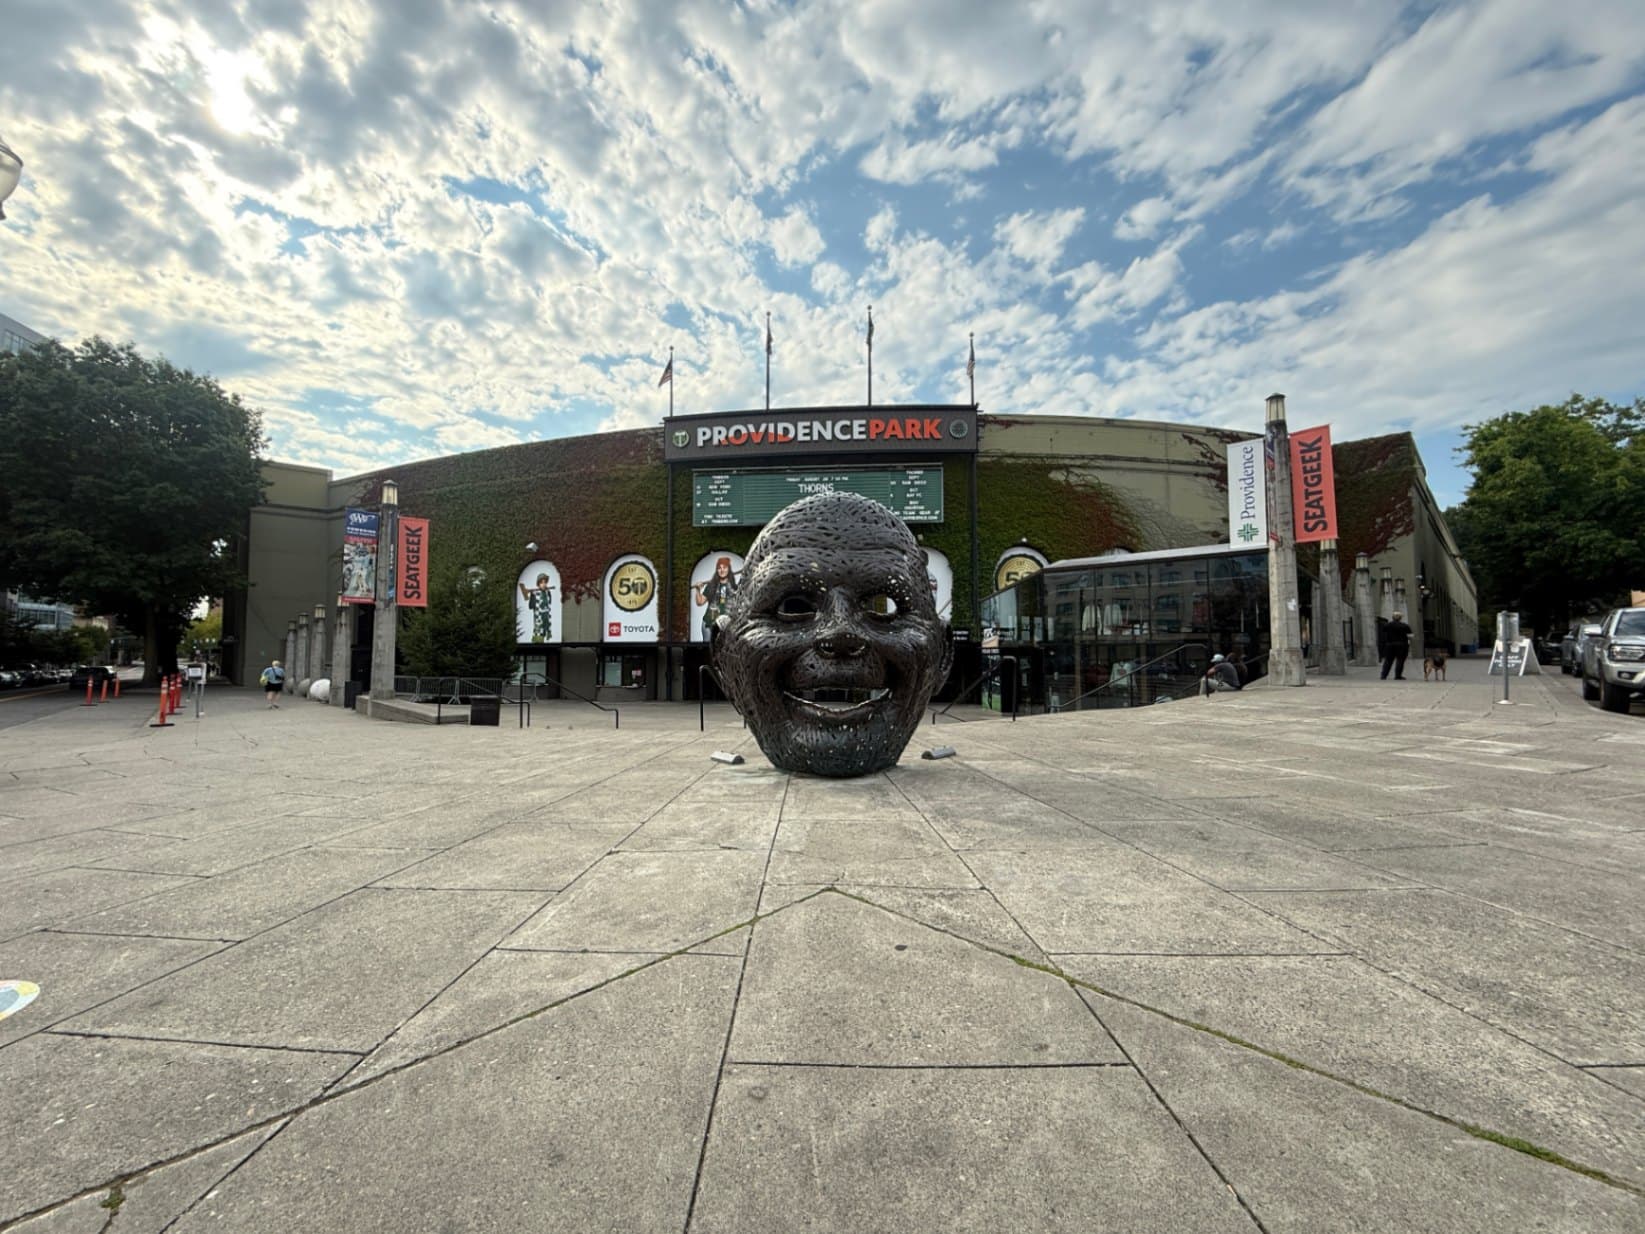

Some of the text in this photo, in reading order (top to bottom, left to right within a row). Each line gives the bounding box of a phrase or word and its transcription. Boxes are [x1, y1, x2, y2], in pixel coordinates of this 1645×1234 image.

[697, 418, 942, 447] PROVIDENCE PARK
[798, 483, 834, 494] THORNS
[1238, 446, 1256, 520] Providence
[1298, 435, 1328, 533] SEATGEEK
[404, 525, 423, 600] SEATGEEK
[623, 625, 655, 633] TOYOTA
